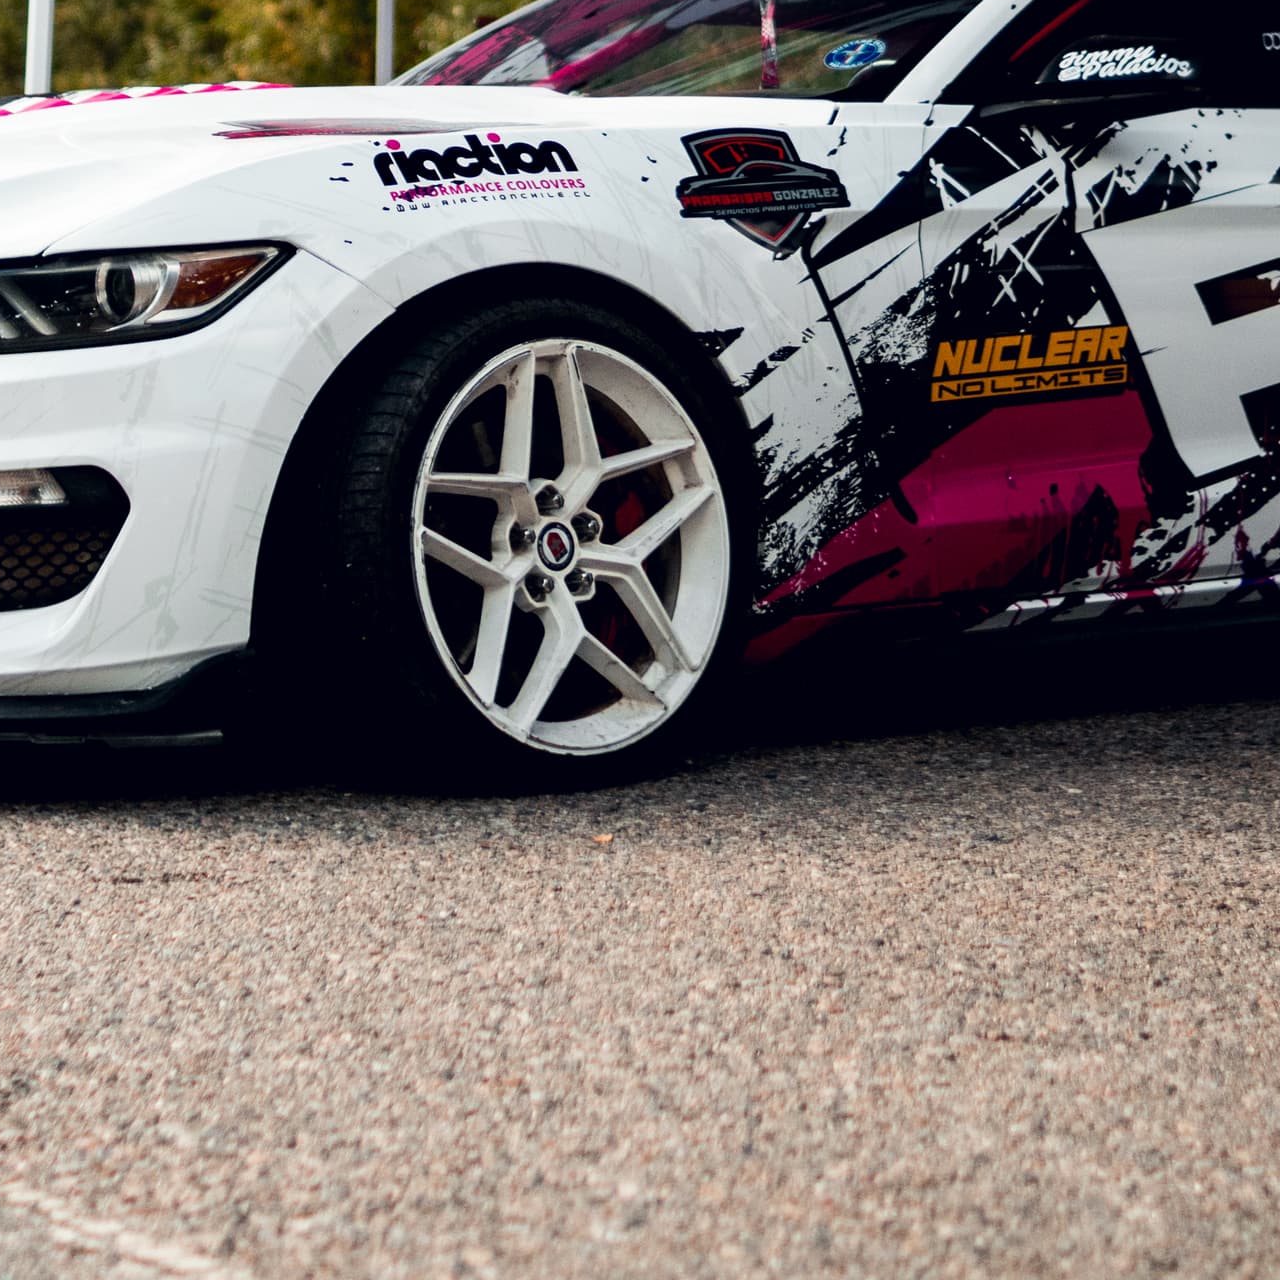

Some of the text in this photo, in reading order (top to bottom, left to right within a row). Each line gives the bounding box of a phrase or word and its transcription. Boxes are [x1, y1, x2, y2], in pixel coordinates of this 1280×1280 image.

[1081, 53, 1194, 81] Palacios
[373, 132, 579, 186] riaction
[506, 178, 587, 196] COILOVERS
[932, 325, 1129, 378] NUCLEAR
